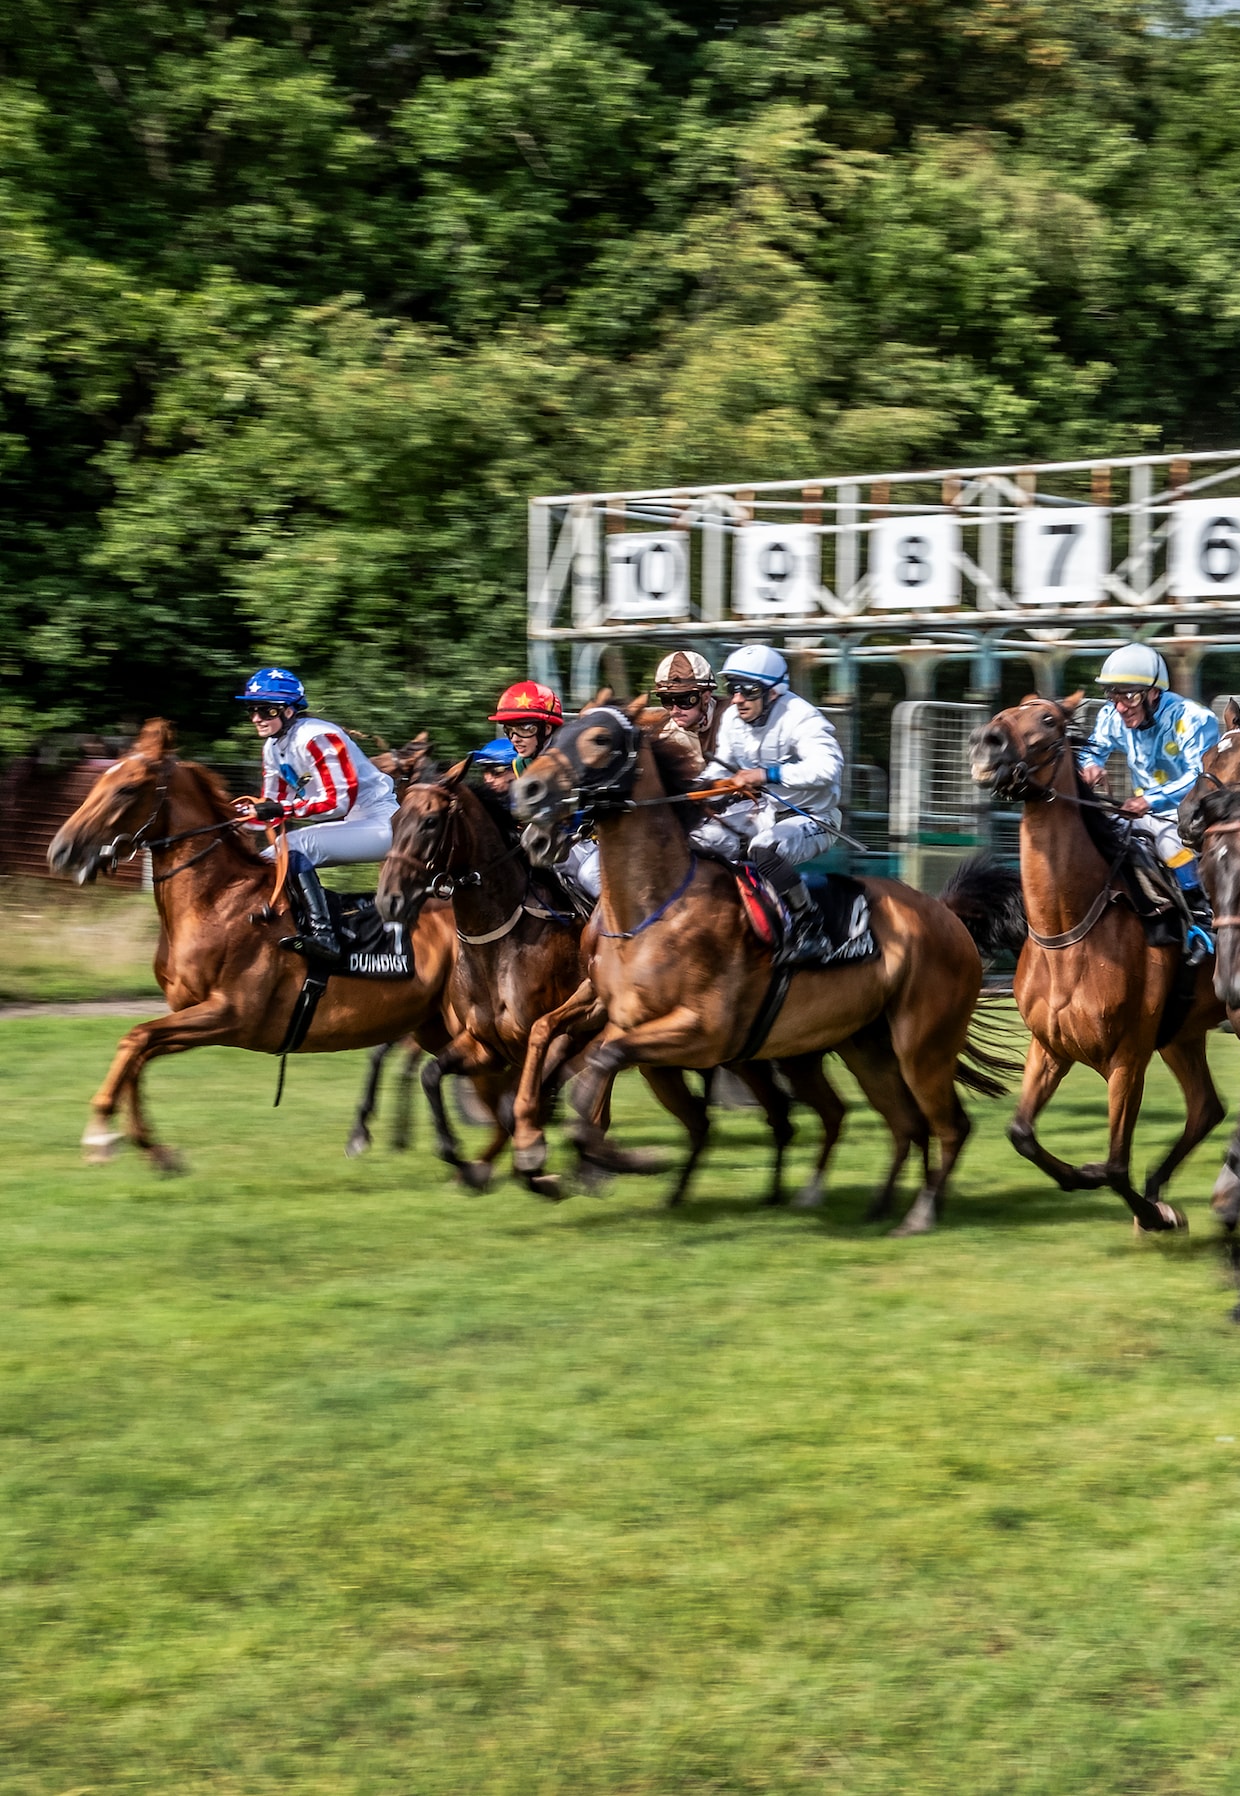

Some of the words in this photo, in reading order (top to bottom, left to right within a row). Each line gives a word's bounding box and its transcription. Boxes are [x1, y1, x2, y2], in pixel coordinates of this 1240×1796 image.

[612, 544, 682, 602] 10
[758, 541, 798, 603] 9
[896, 535, 931, 588] 8
[1039, 523, 1083, 587] 7
